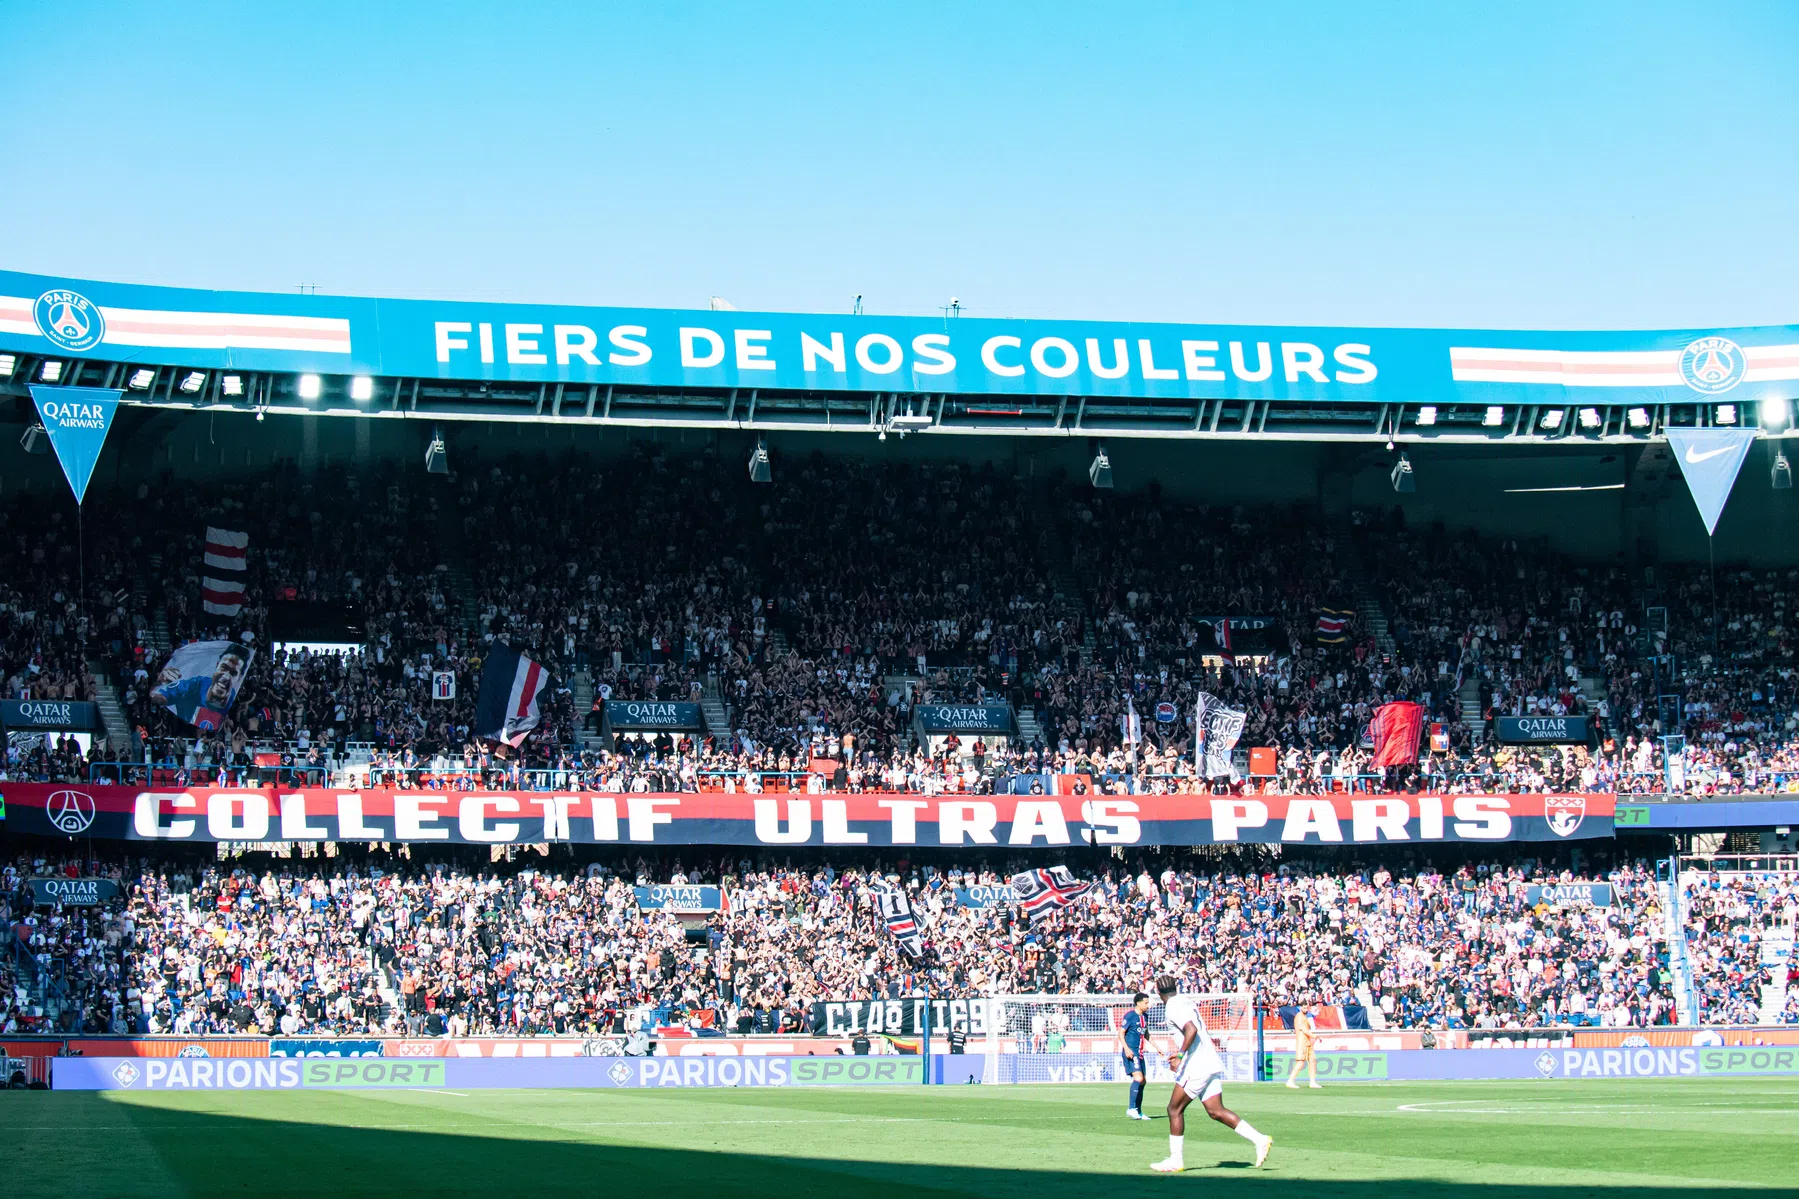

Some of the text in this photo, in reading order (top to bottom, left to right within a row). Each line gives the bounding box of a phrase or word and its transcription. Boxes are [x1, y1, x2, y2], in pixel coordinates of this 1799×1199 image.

[44, 293, 88, 310] PARIS
[434, 321, 1378, 384] FIERS DE NOS COULEURS
[43, 402, 104, 420] QATAR
[59, 418, 105, 429] AIRWAYS
[20, 702, 71, 717] QATAR
[627, 703, 677, 718] QATAR
[939, 707, 988, 722] QATAR
[32, 716, 72, 725] AIRWAYS
[640, 716, 677, 724] AIRWAYS
[951, 720, 988, 729] AIRWAYS
[1518, 719, 1566, 733] QATAR
[1530, 730, 1567, 738] AIRWAYS
[134, 792, 1512, 845] COLLECTIF ULTRAS PARIS
[45, 880, 98, 896] QATAR
[651, 887, 702, 903] QATAR
[970, 887, 1021, 903] QATAR
[1541, 886, 1592, 902] QATAR
[1563, 1048, 1696, 1075] PARIONS
[146, 1060, 439, 1088] PARIONS SPORT
[640, 1058, 922, 1086] PARIONS SPORT
